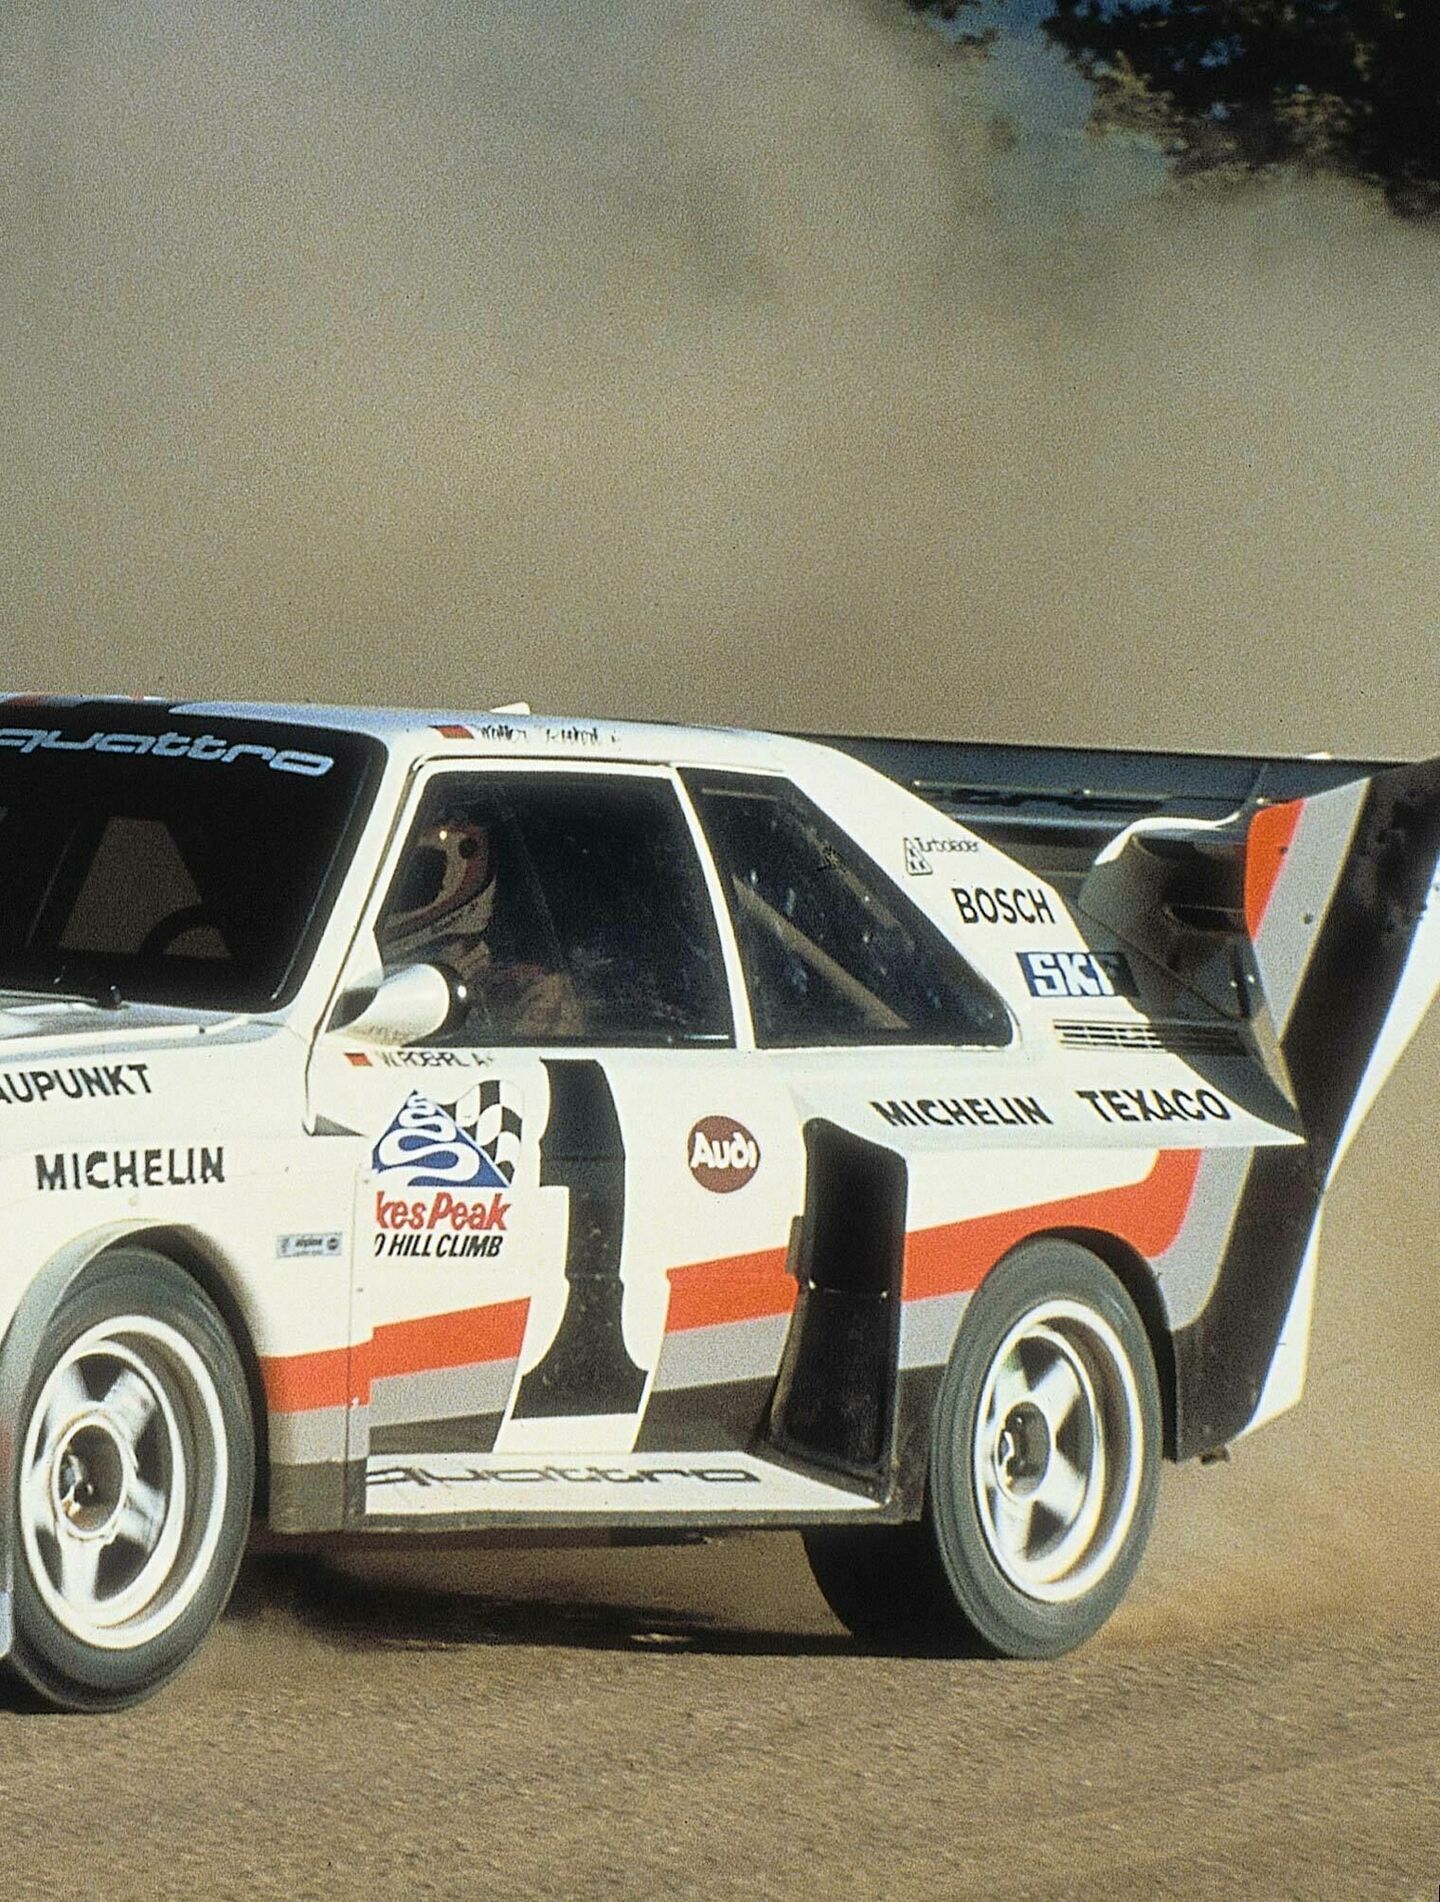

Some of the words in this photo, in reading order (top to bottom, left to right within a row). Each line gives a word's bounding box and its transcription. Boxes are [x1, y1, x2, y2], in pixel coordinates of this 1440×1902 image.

[952, 887, 1056, 924] BOSCH
[1027, 953, 1120, 995] SKF
[870, 1097, 1054, 1127] MICHELIN
[1076, 1089, 1232, 1123] TEXACO
[35, 1147, 226, 1191] MICHELIN
[426, 1191, 512, 1231] Peak
[388, 1233, 433, 1257] HILL
[435, 1234, 504, 1258] CLIMB
[510, 1057, 649, 1420] 1
